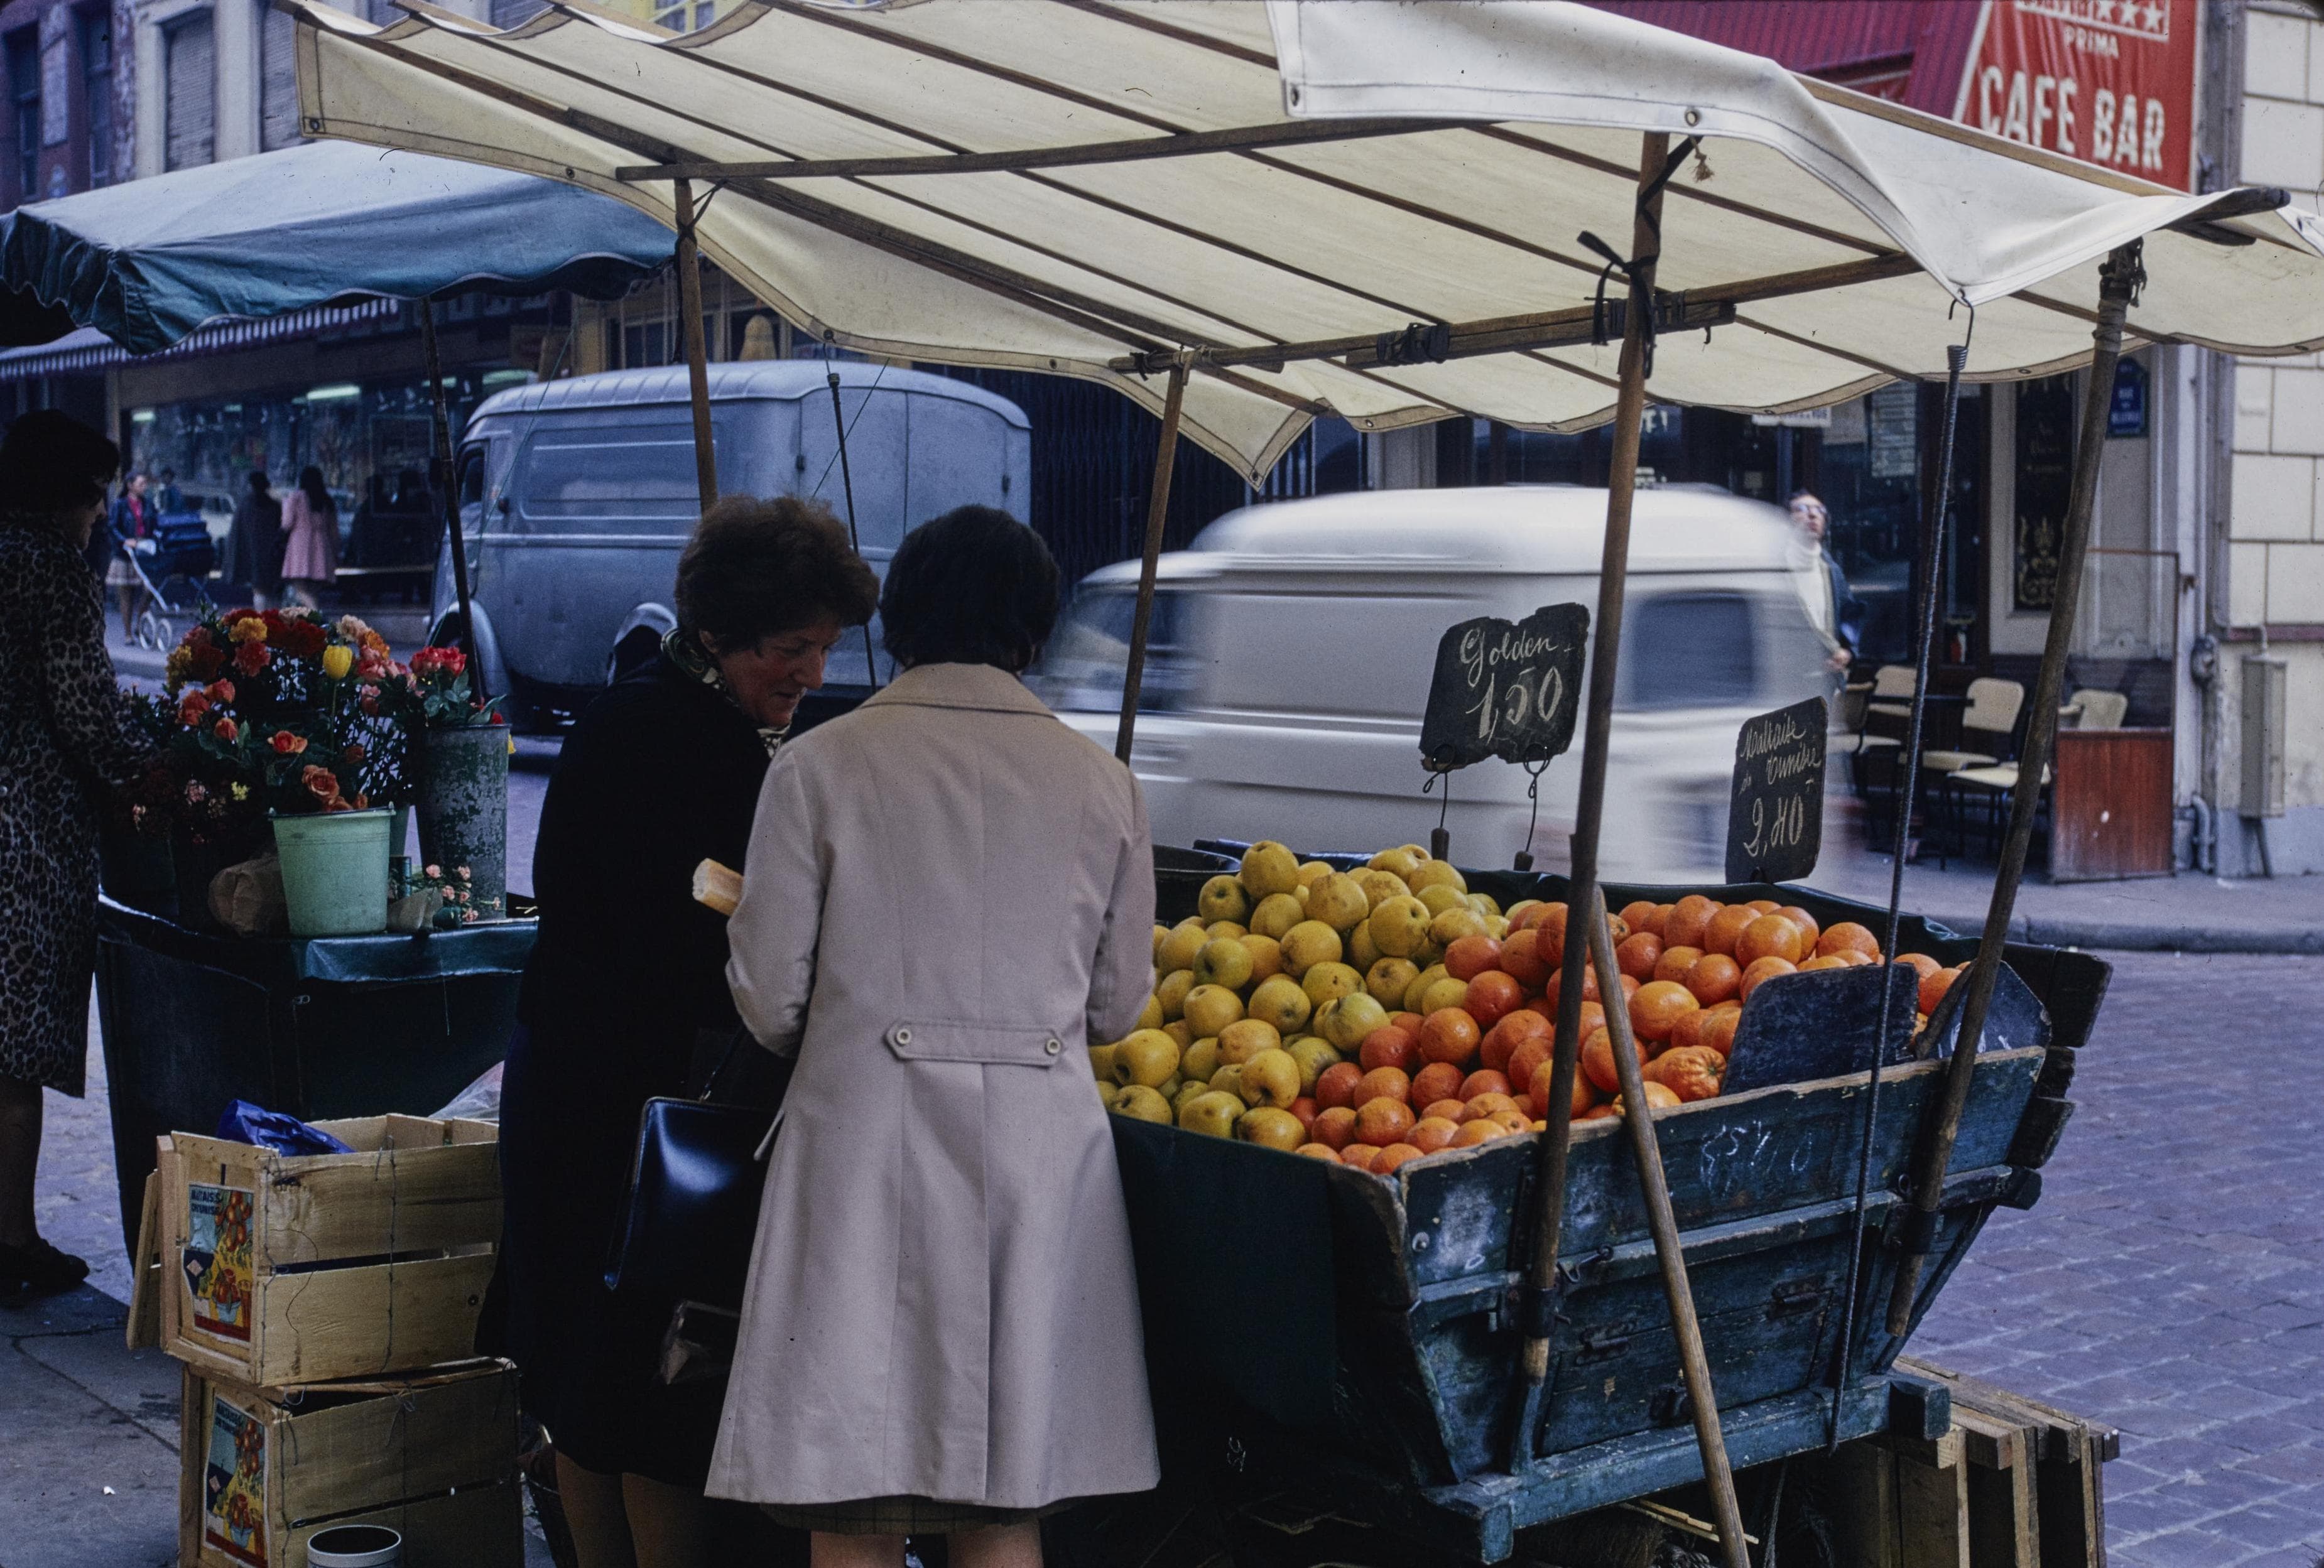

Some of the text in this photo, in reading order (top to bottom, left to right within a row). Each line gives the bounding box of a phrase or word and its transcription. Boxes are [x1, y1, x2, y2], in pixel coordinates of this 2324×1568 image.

[1980, 65, 2166, 171] CAFE BAR
[1460, 627, 1558, 688] Golden
[1465, 666, 1563, 746] 1,50
